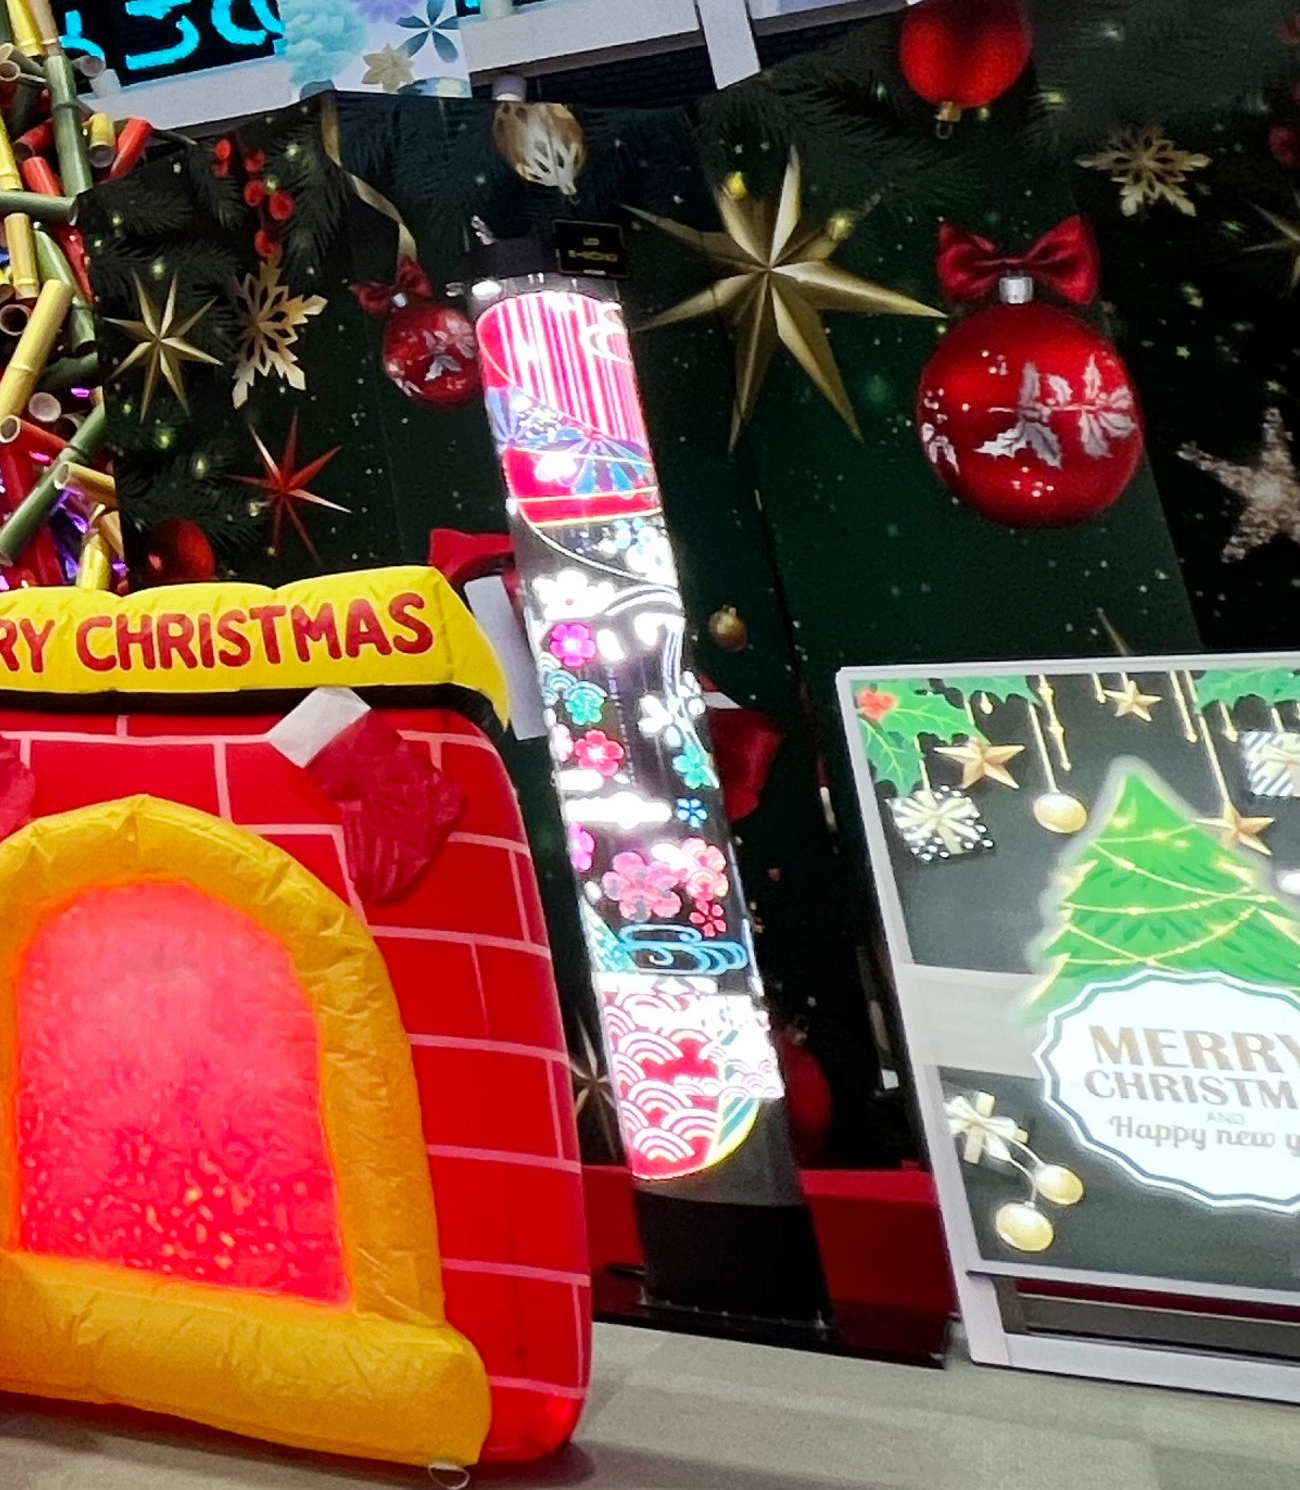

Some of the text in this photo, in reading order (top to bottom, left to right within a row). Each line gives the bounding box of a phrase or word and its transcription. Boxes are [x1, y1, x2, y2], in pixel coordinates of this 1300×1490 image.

[76, 592, 434, 672] CHRISTMAS
[1107, 1114, 1207, 1151] Happy
[1215, 1128, 1276, 1149] new
